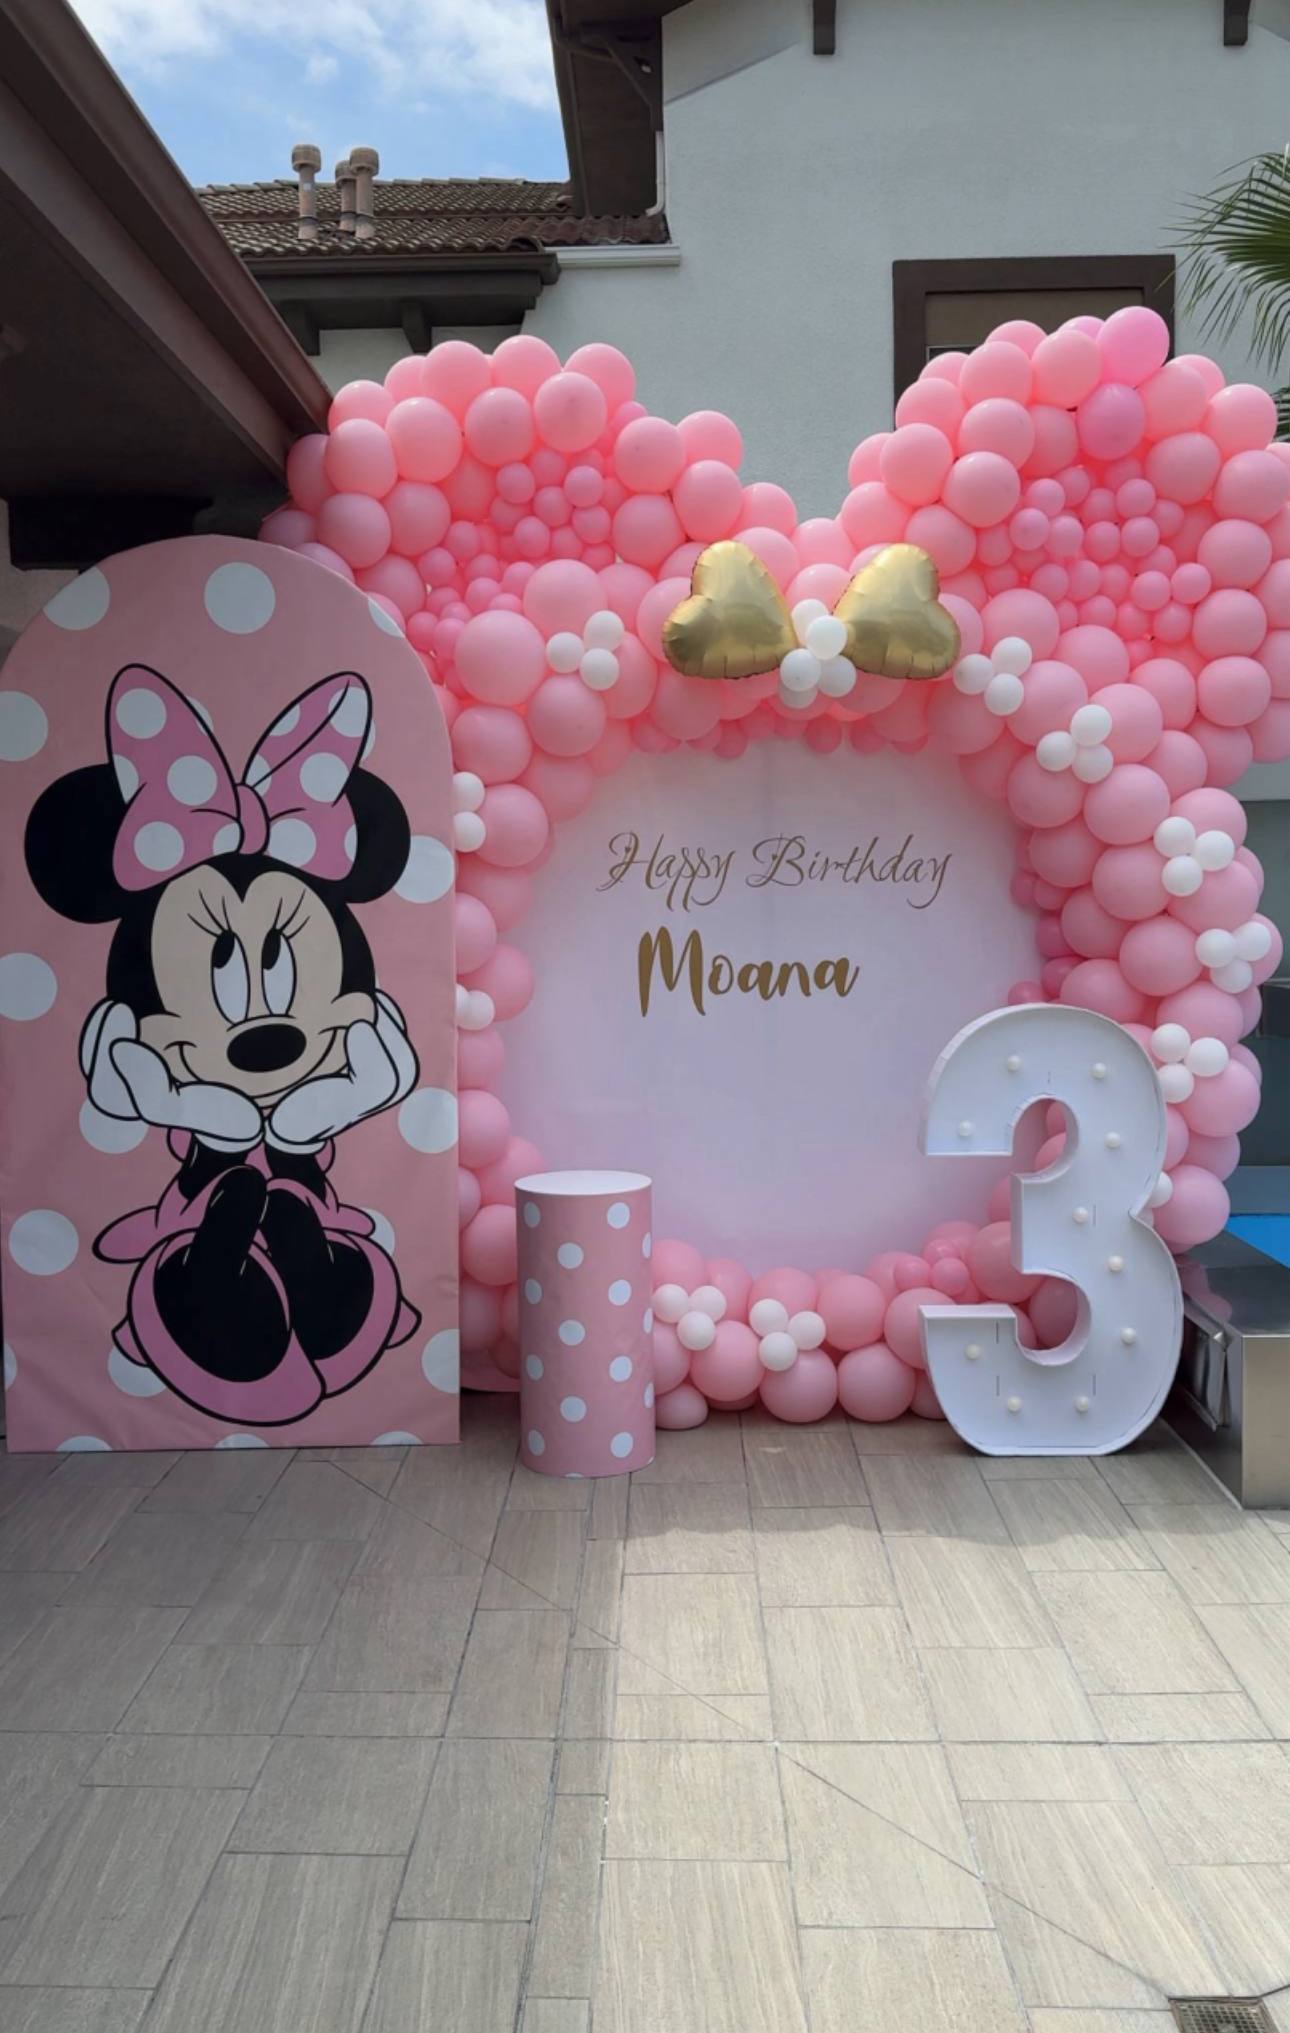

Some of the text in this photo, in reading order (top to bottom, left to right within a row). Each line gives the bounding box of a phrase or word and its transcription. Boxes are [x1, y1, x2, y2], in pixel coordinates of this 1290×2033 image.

[596, 831, 952, 912] Happy Birthday
[637, 926, 860, 1017] Moana
[919, 1003, 1183, 1456] 3
